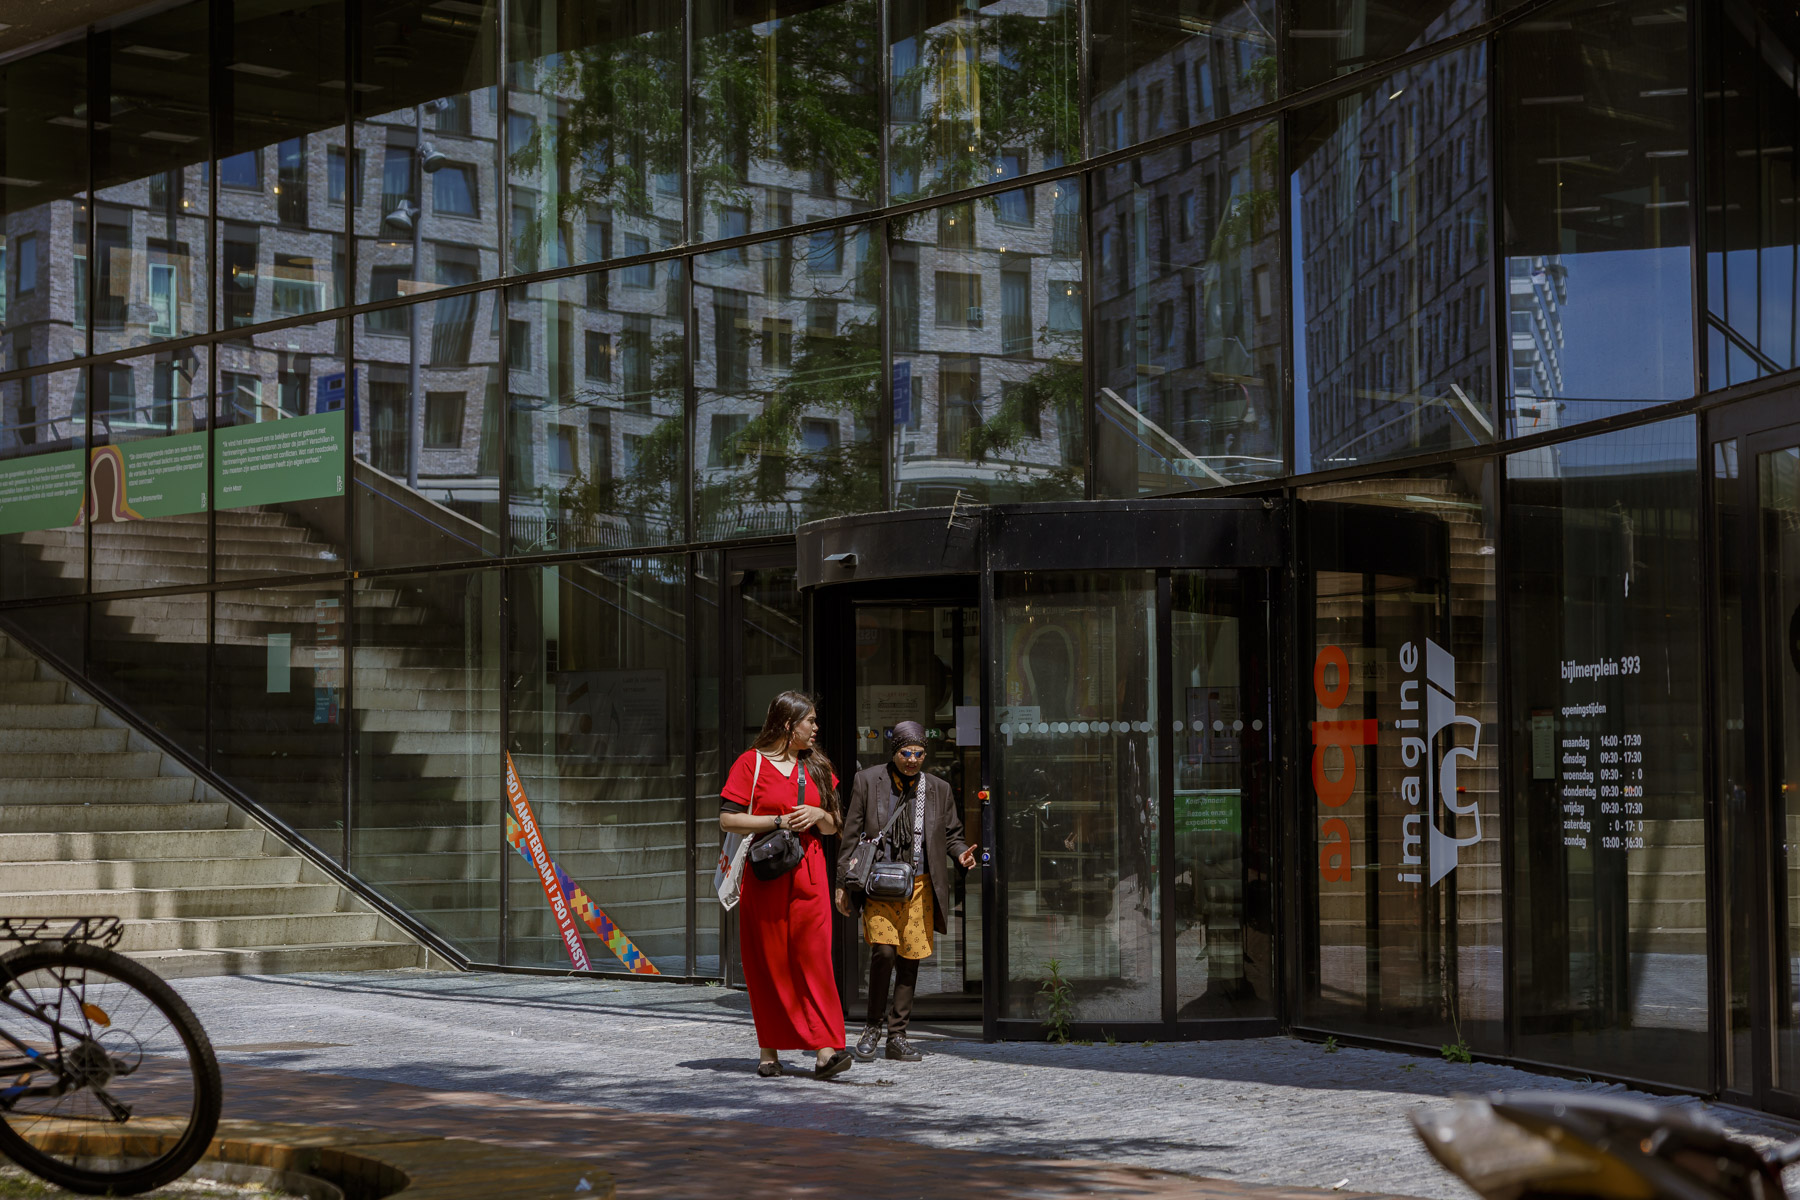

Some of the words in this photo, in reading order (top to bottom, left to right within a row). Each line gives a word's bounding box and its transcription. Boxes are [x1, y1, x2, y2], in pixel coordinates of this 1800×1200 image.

[1561, 657, 1618, 683] bijlmerplein
[1621, 656, 1640, 674] 393
[1562, 702, 1606, 718] openingstijden
[1563, 736, 1589, 750] maandag
[1600, 735, 1618, 746] 14:00
[1623, 735, 1641, 746] 17:30
[1397, 641, 1426, 883] imagine
[1563, 752, 1586, 766] dinsdag
[1600, 752, 1618, 763] 09:30
[1624, 752, 1641, 763] 17:30
[1563, 769, 1594, 783] woensdag
[1601, 769, 1618, 780] 09:30
[1564, 785, 1596, 799] donderdag
[1601, 786, 1619, 797] 09:30
[1624, 785, 1643, 797] 20:00
[1564, 802, 1584, 816] vrijdag
[1601, 803, 1619, 814] 09:30
[1625, 803, 1643, 814] 17:30
[1564, 819, 1591, 832] zaterdag
[1564, 835, 1586, 849] zondag
[1602, 837, 1619, 848] 13:00
[1625, 837, 1643, 848] 16:30
[516, 801, 554, 886] AMSTERDAM
[551, 891, 566, 921] 750
